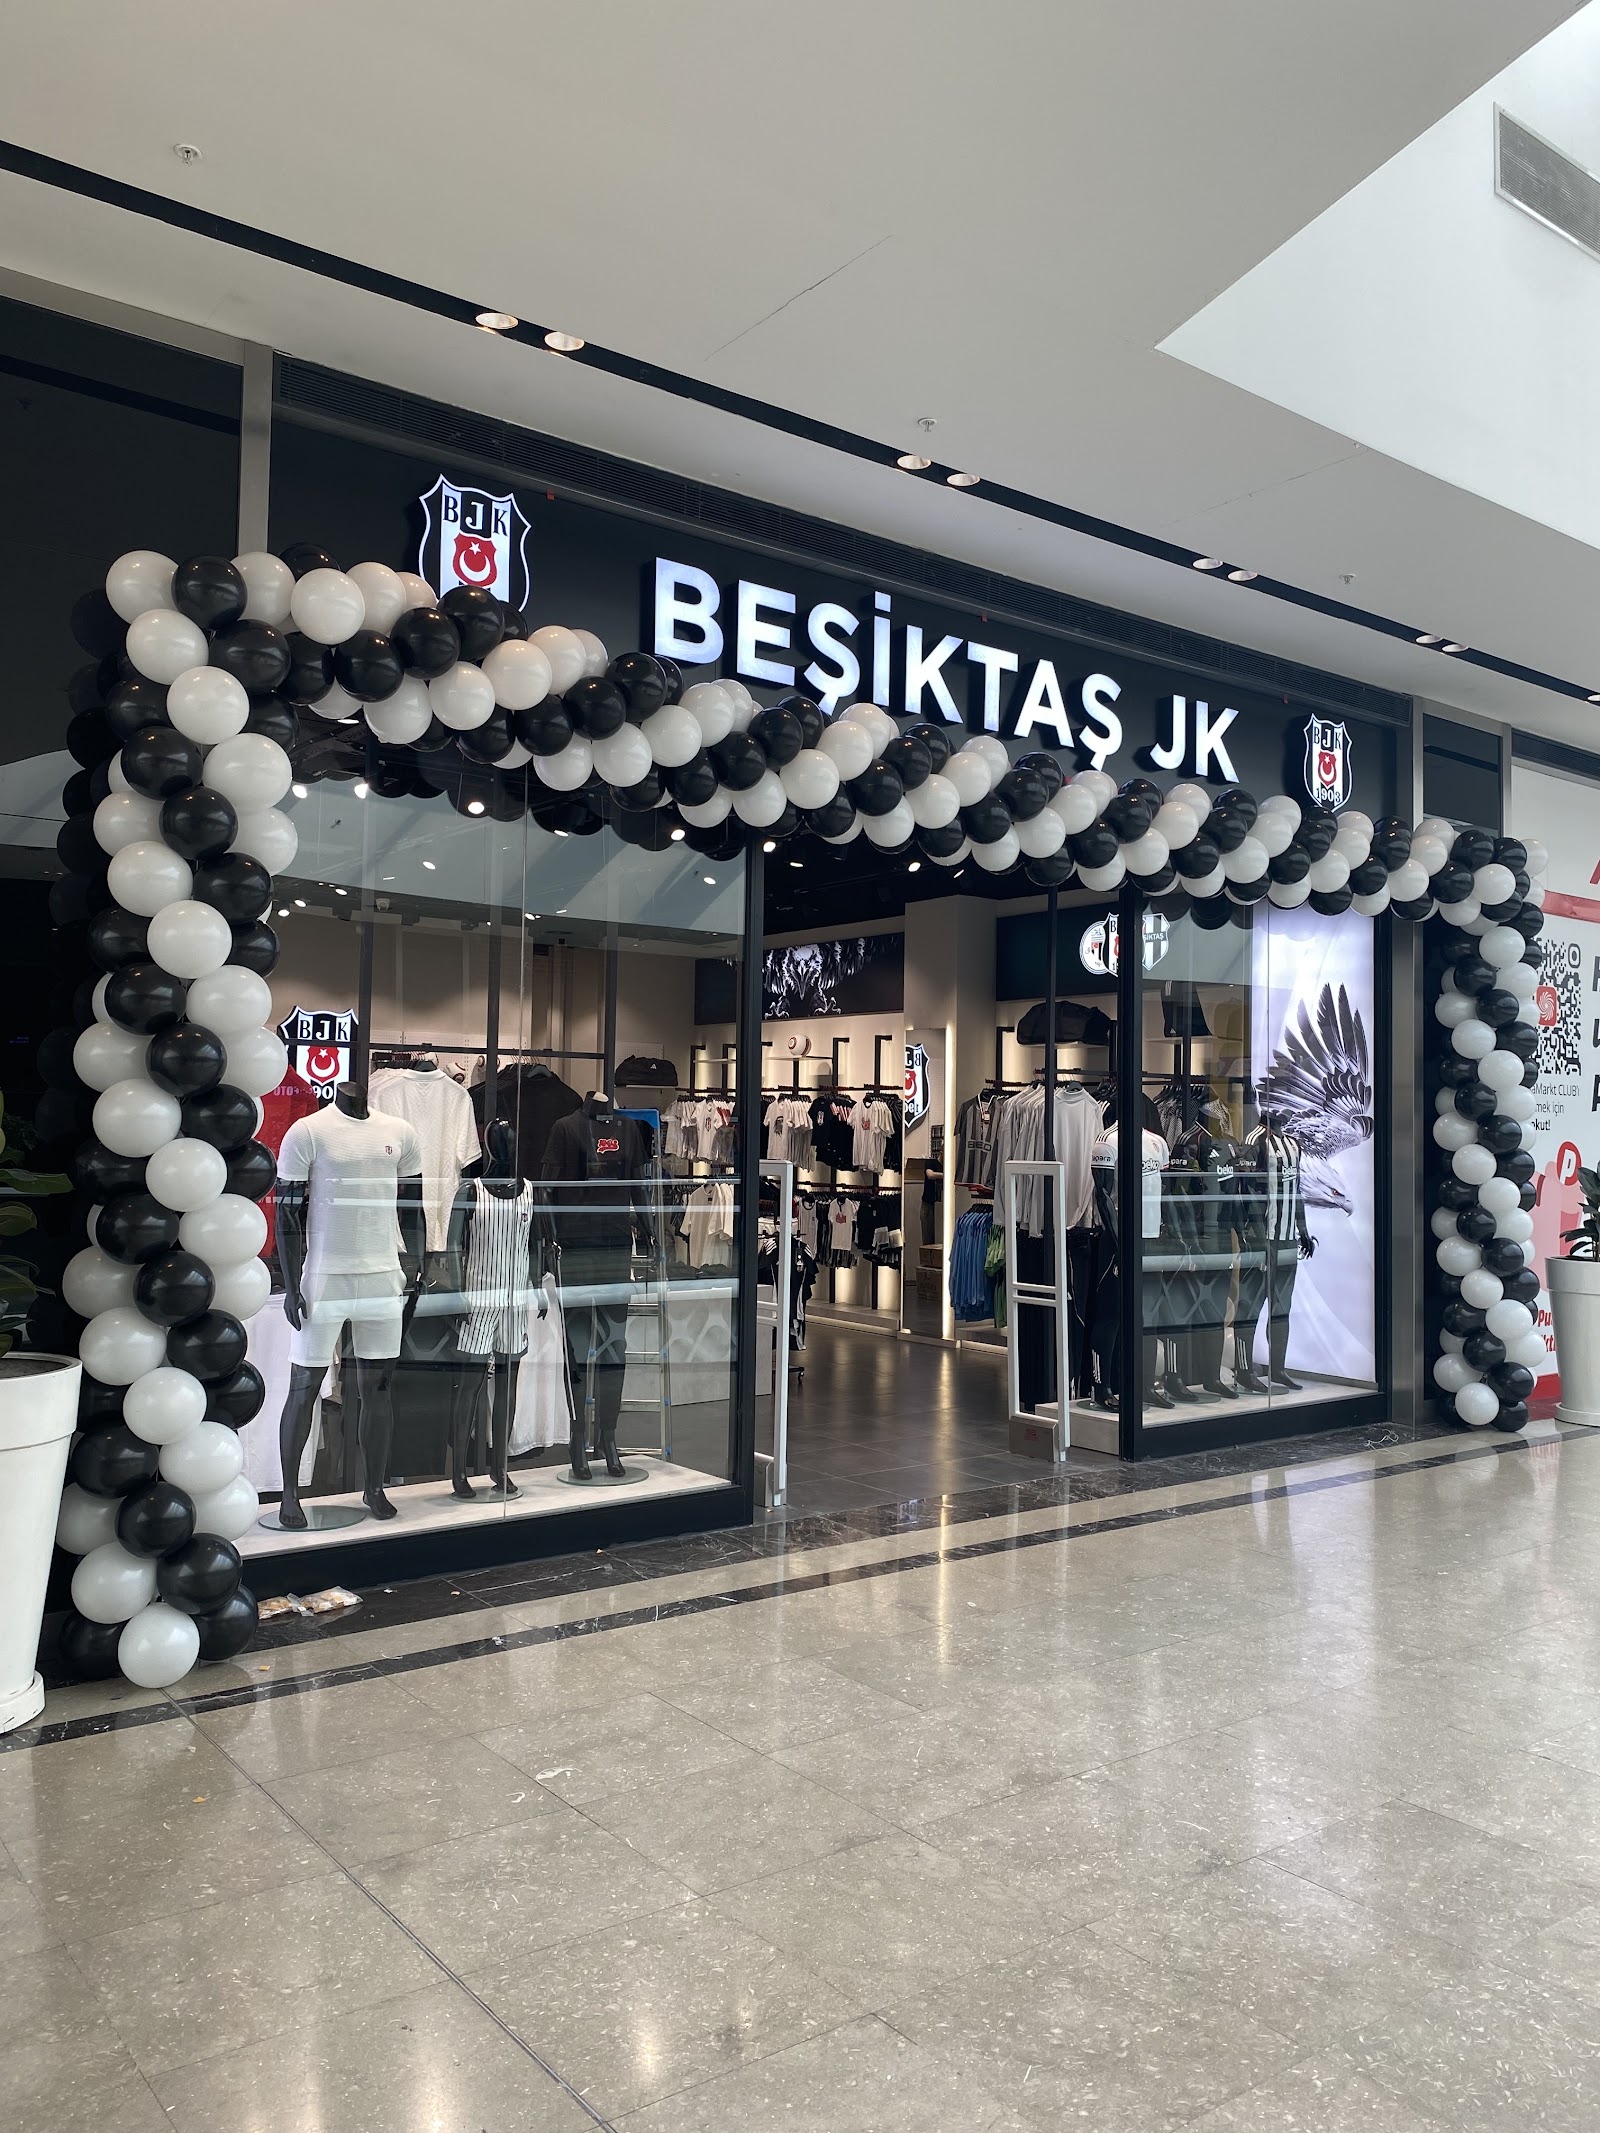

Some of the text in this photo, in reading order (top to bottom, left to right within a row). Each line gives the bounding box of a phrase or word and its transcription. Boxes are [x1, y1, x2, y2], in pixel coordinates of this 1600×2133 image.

[443, 493, 508, 537] BJK
[654, 557, 1239, 783] BEŞİKTAŞ JK
[1313, 726, 1342, 750] BJK
[1316, 787, 1341, 803] 1903
[299, 1019, 349, 1041] BJK
[1531, 1083, 1557, 1096] aMarkt
